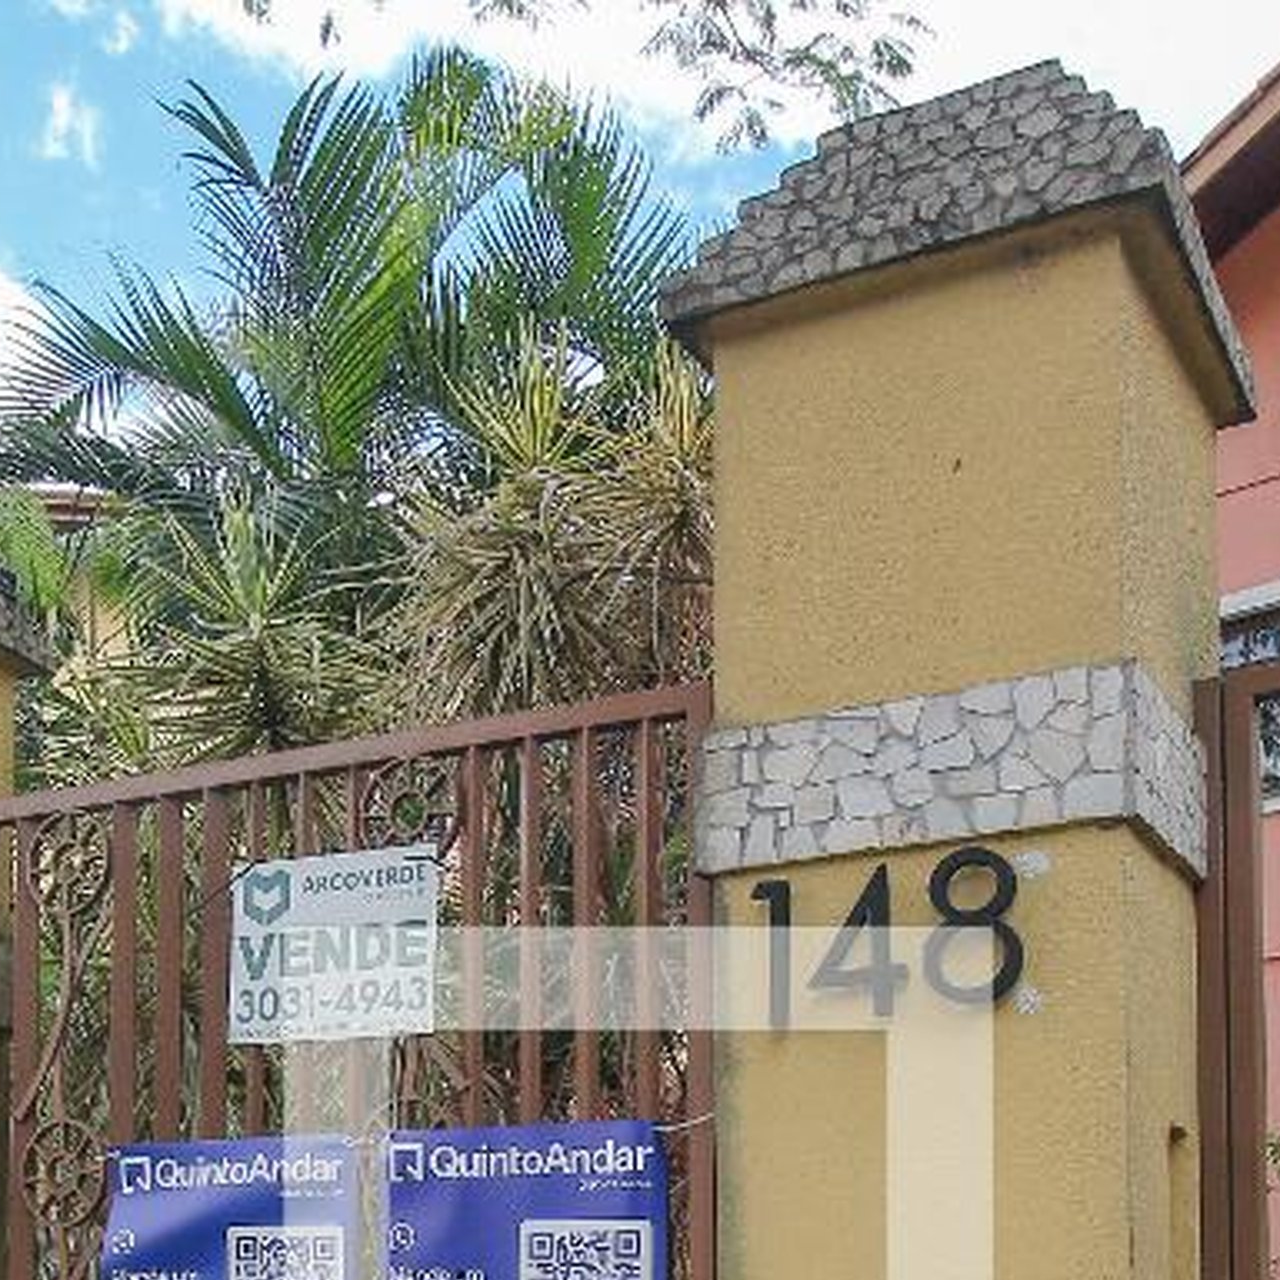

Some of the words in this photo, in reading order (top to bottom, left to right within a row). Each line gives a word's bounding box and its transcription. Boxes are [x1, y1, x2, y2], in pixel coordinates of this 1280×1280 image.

[302, 863, 427, 894] ARCOVERDE
[238, 919, 428, 981] VENDE
[749, 845, 1025, 1036] 148
[235, 977, 428, 1024] 3031-4943
[154, 1152, 344, 1189] QuintoAndar
[429, 1139, 655, 1179] QuintoAndar
